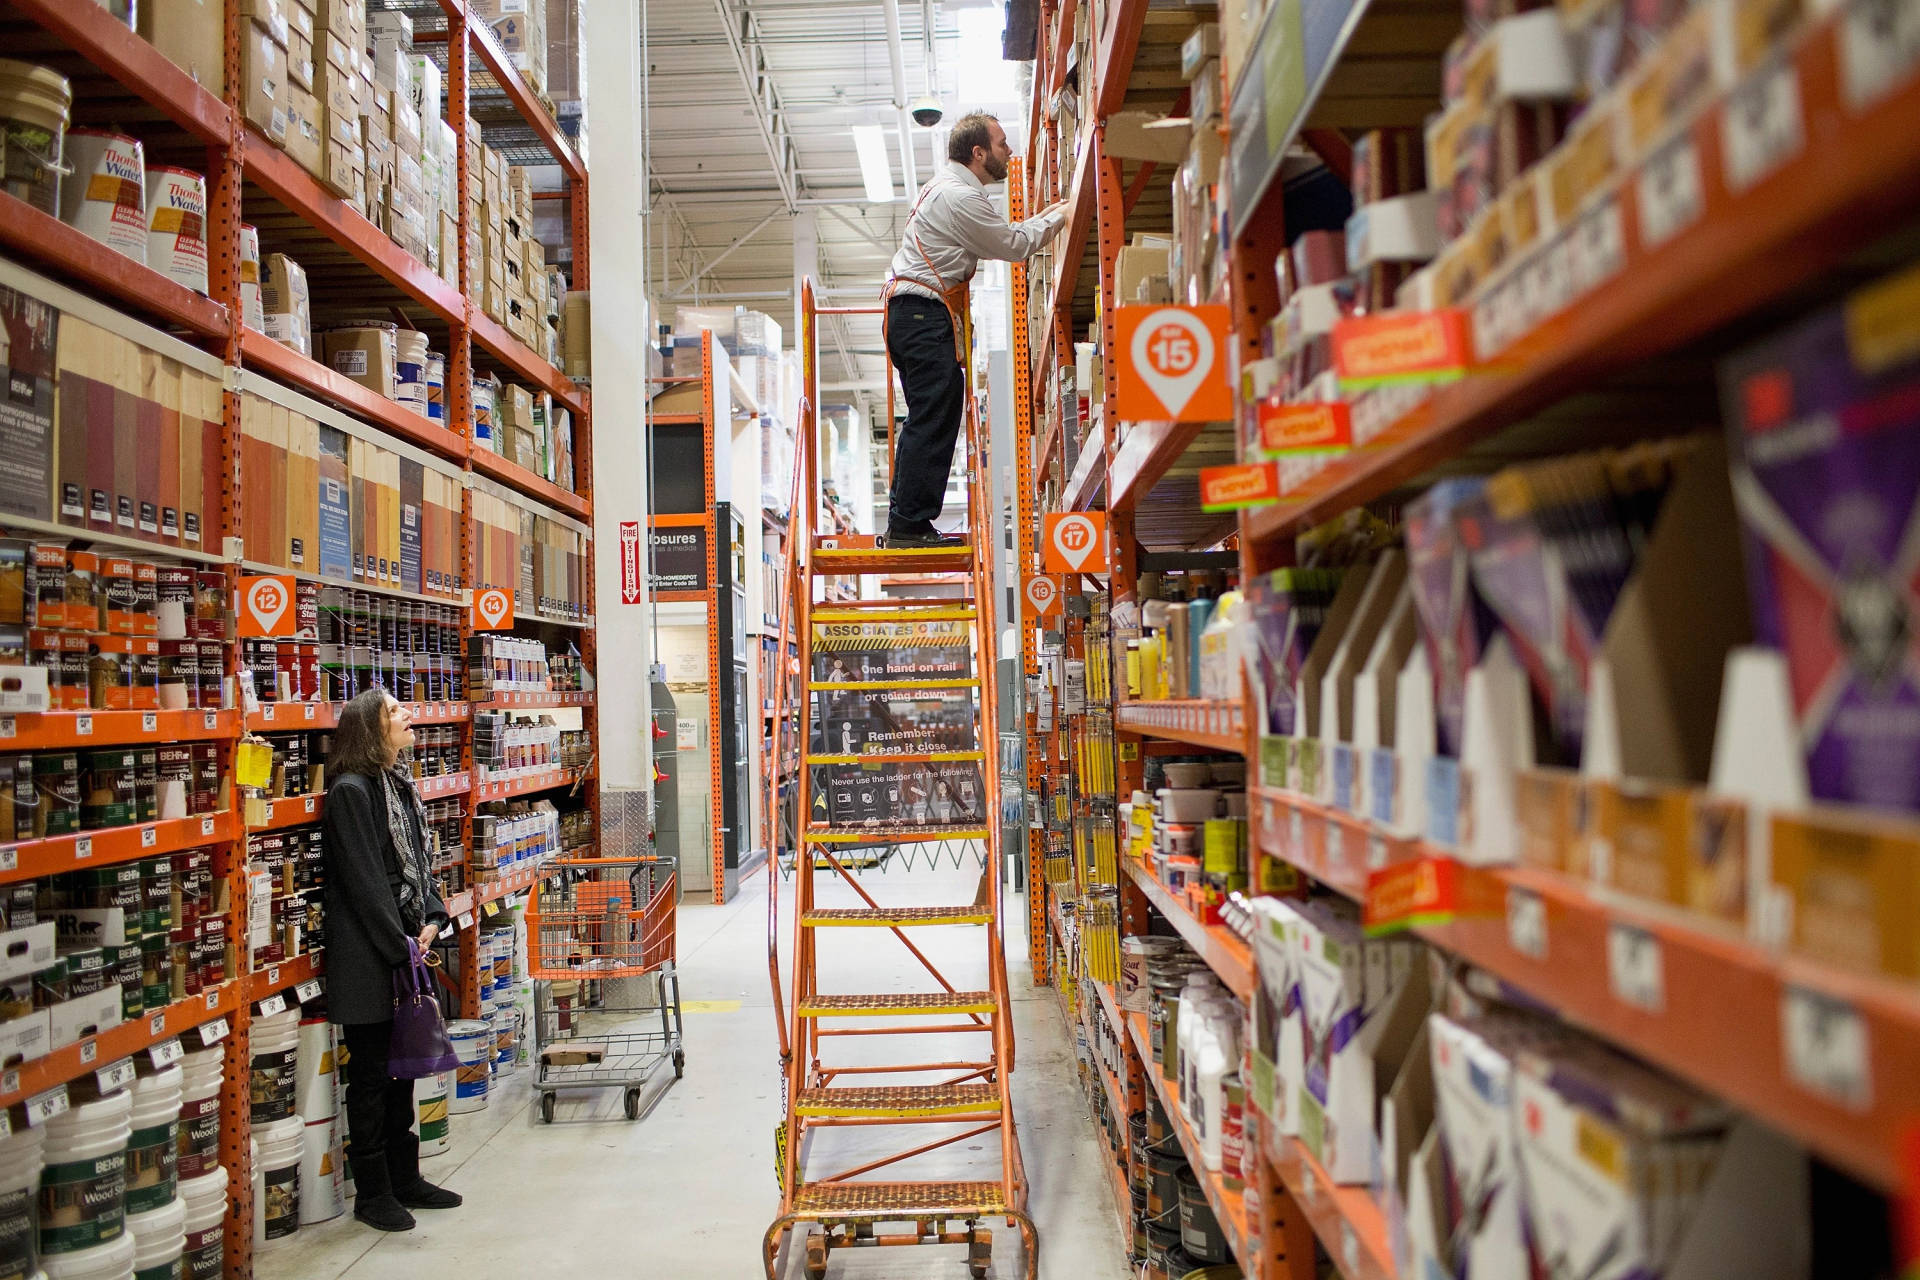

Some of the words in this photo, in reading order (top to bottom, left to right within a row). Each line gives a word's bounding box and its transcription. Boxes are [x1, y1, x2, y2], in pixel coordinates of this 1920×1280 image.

[1160, 328, 1182, 337] BAY
[1152, 339, 1193, 371] 15
[622, 529, 636, 537] FIRE
[1064, 531, 1084, 546] 17
[36, 578, 53, 587] ood
[159, 572, 182, 582] BEHR
[1033, 587, 1049, 598] 19
[257, 594, 277, 609] 12
[485, 601, 500, 612] 14
[824, 624, 913, 637] ASSOCIATES
[918, 622, 955, 634] ONLY
[172, 666, 193, 674] Wood
[861, 665, 883, 674] One
[886, 663, 916, 674] hand
[919, 664, 933, 672] on
[937, 662, 957, 672] rail
[864, 693, 878, 702] or
[881, 691, 911, 703] going
[914, 690, 947, 700] down
[868, 729, 936, 742] Remember:
[868, 745, 901, 754] Keep
[904, 743, 914, 753] it
[918, 742, 947, 751] close
[160, 750, 183, 761] BEHR
[831, 778, 854, 787] Never
[856, 777, 870, 785] use
[872, 775, 885, 783] the
[886, 773, 911, 782] ladder
[913, 772, 924, 780] for
[925, 771, 938, 779] the
[939, 768, 974, 778] following:
[110, 896, 134, 906] Wood
[112, 973, 136, 984] Wood
[73, 982, 97, 994] Wood
[277, 1077, 294, 1086] Wood
[191, 1129, 213, 1140] Wood
[84, 1190, 113, 1204] Wood
[193, 1257, 216, 1271] Wood
